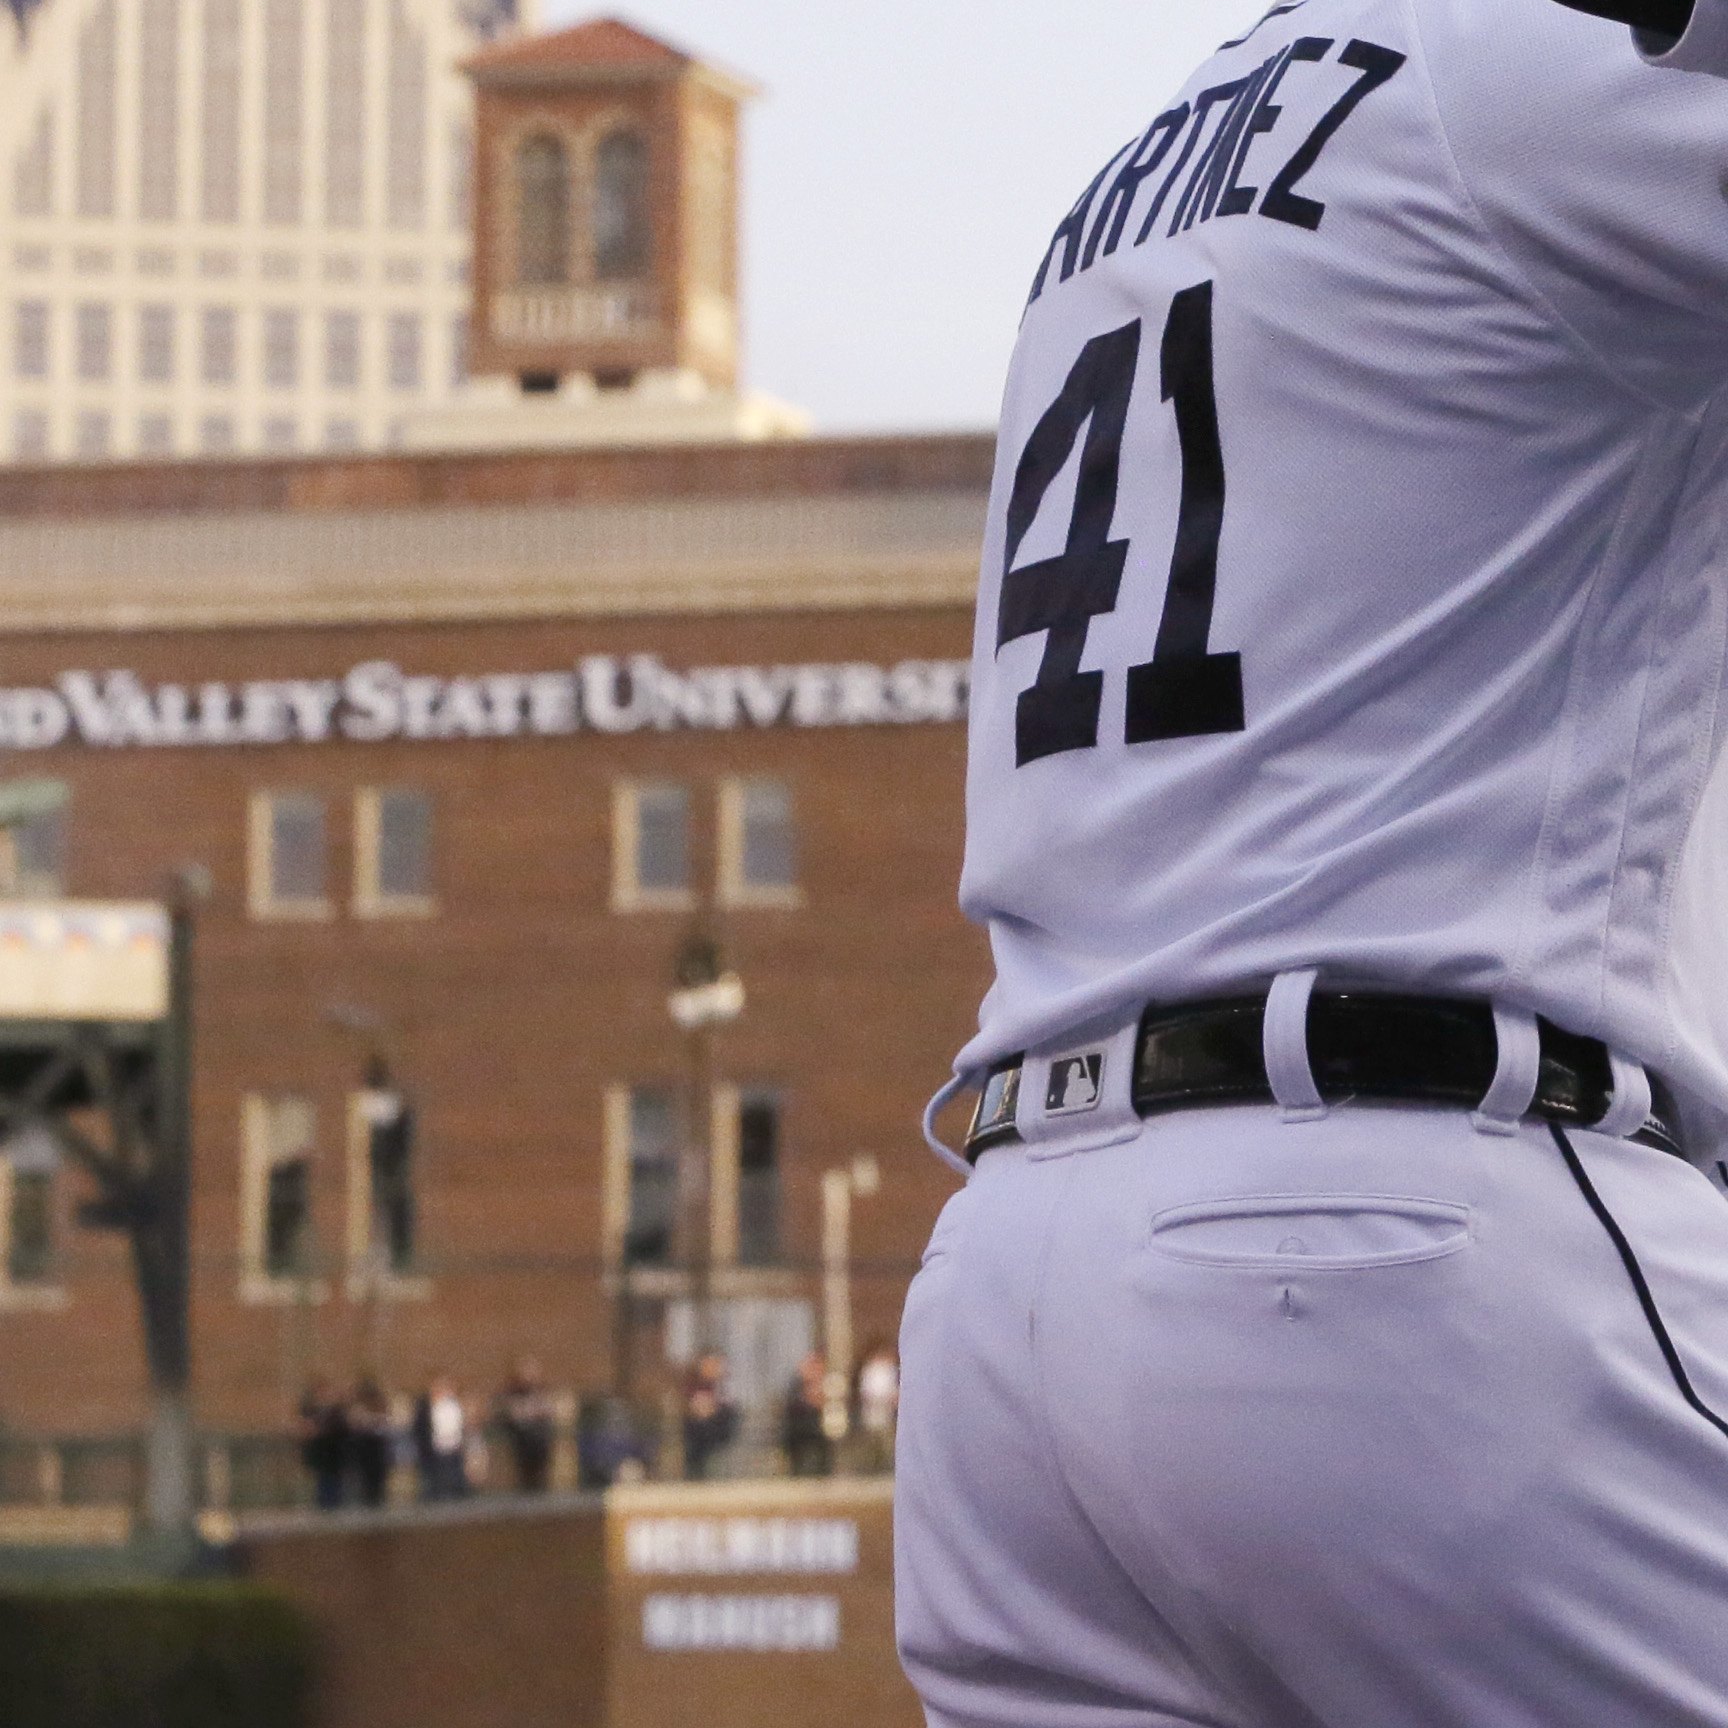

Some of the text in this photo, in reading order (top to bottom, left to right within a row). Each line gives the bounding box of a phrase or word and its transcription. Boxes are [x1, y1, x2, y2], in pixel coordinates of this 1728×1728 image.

[1019, 36, 1408, 328] ARTINEZ
[995, 279, 1245, 768] 41
[578, 652, 973, 732] UNIVERSI
